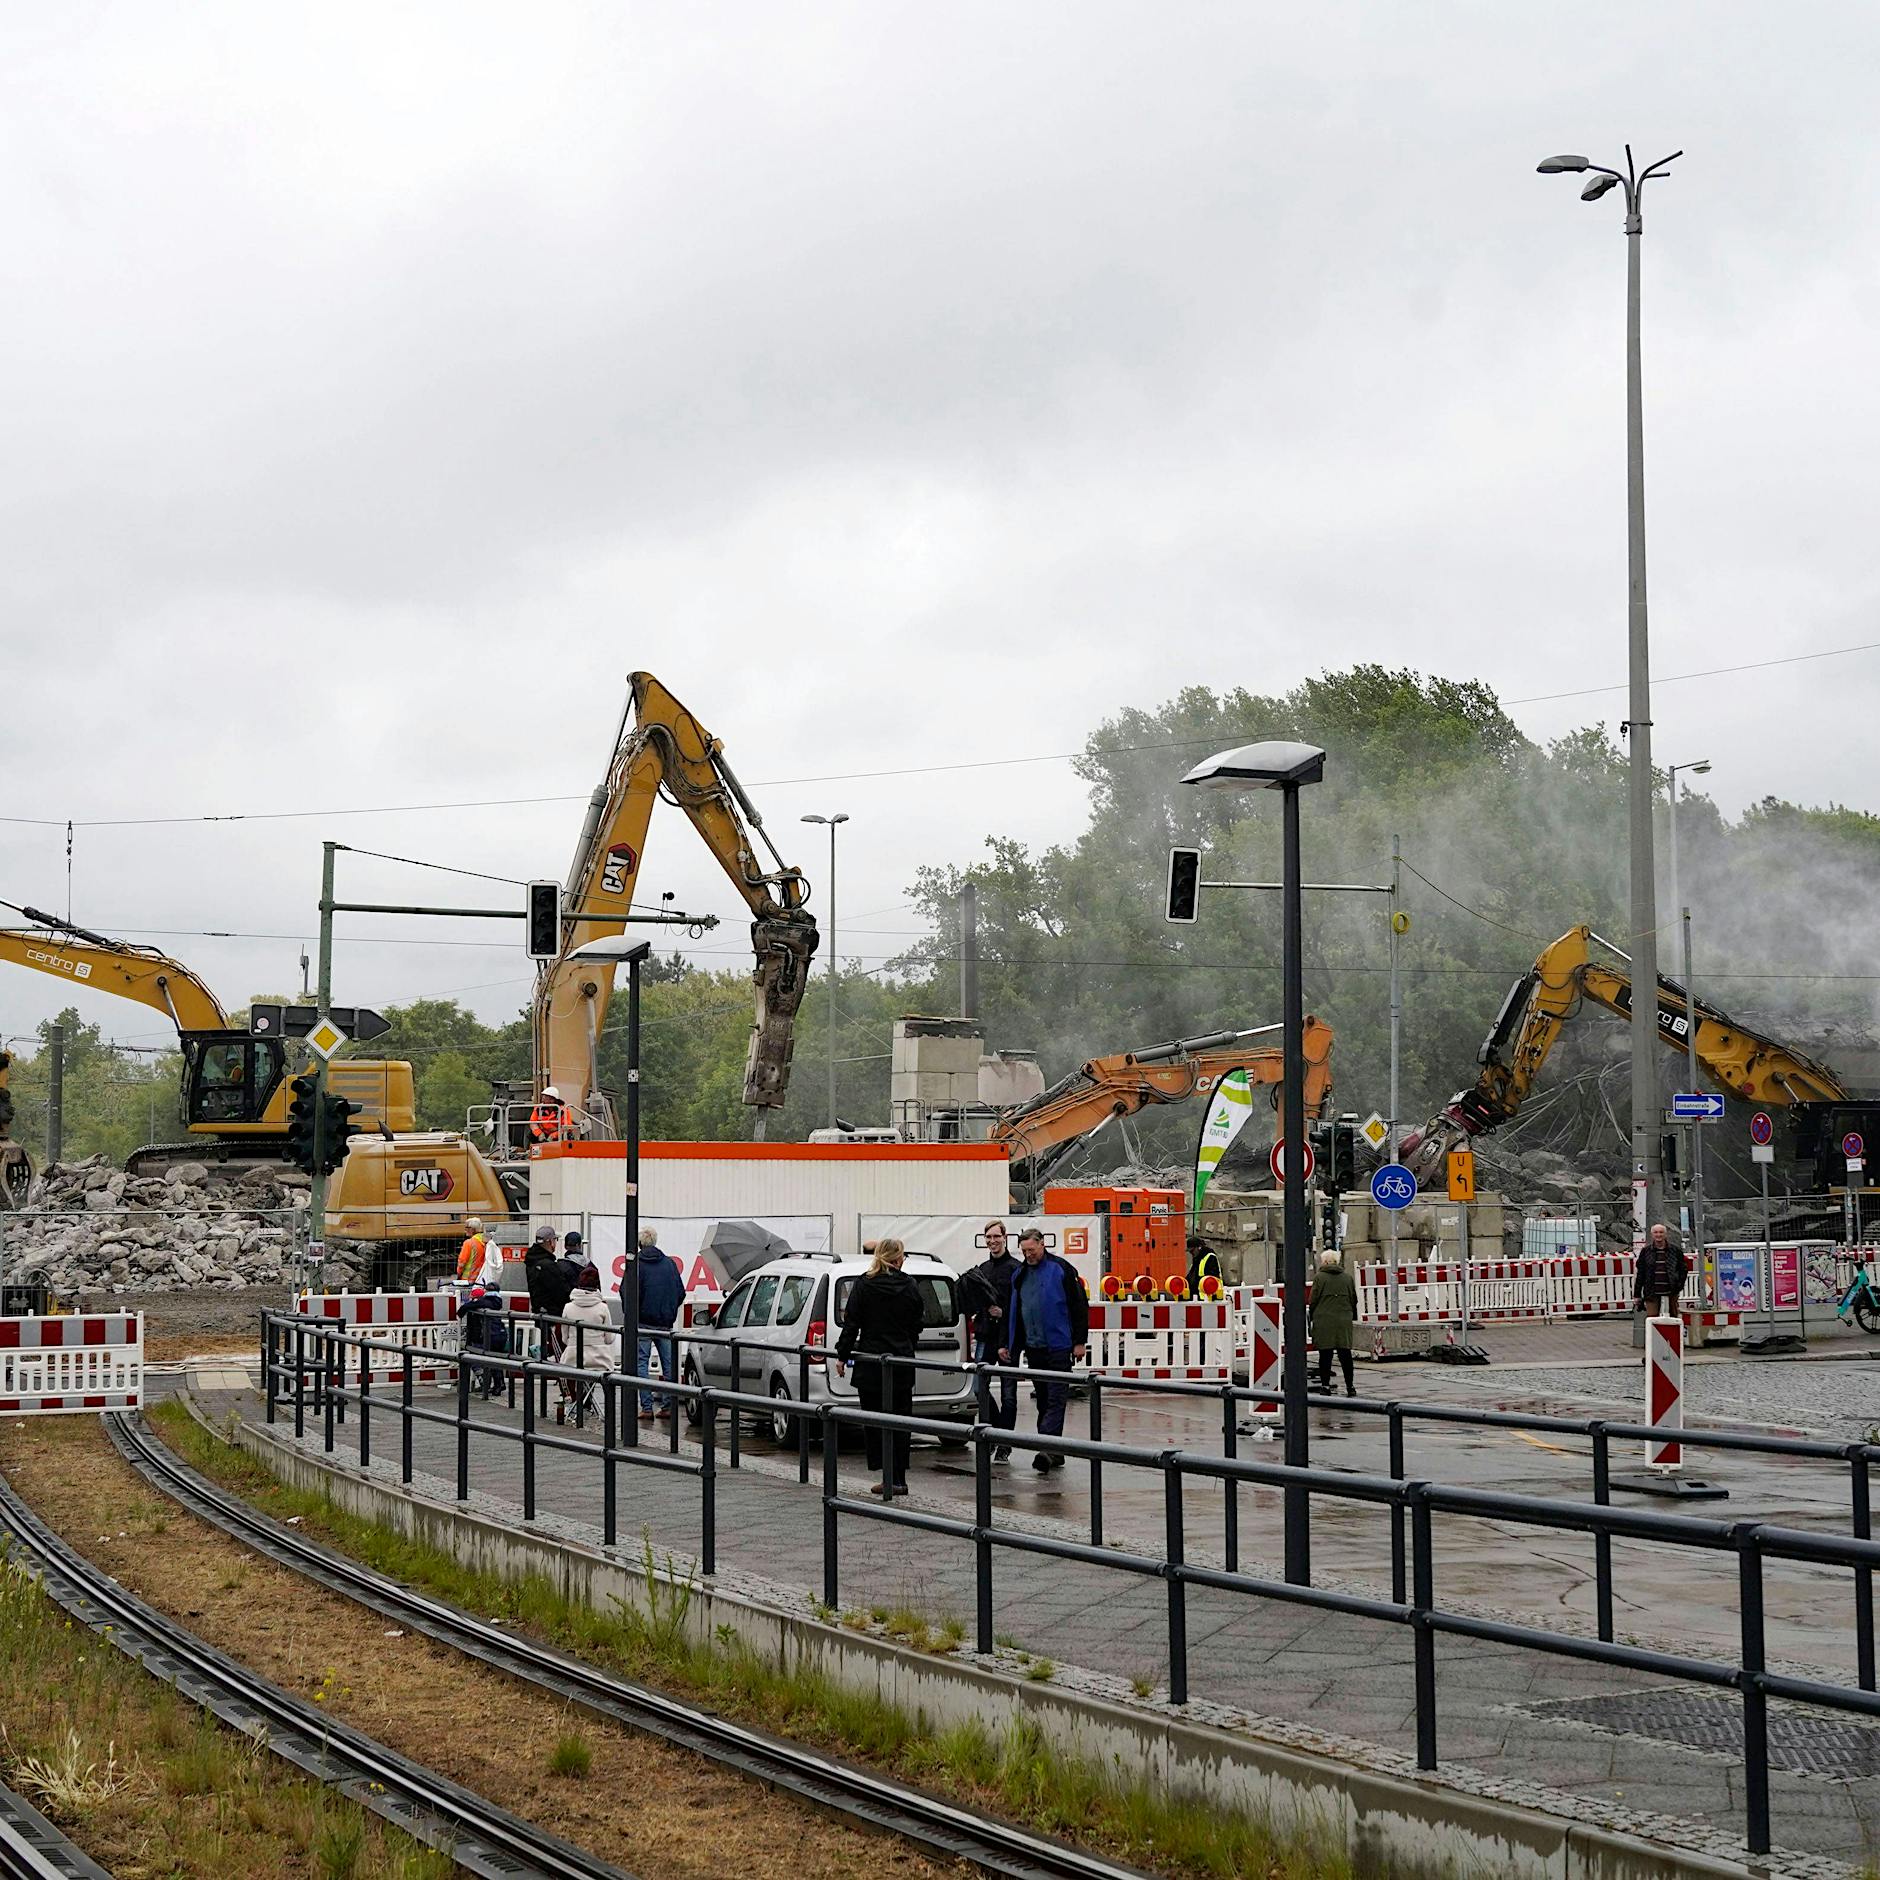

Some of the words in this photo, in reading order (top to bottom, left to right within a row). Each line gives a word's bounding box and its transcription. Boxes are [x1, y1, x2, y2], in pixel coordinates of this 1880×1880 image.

[601, 852, 629, 893] CAT
[26, 949, 73, 971] centro
[1457, 1156, 1464, 1166] U
[401, 1169, 441, 1195] CAT
